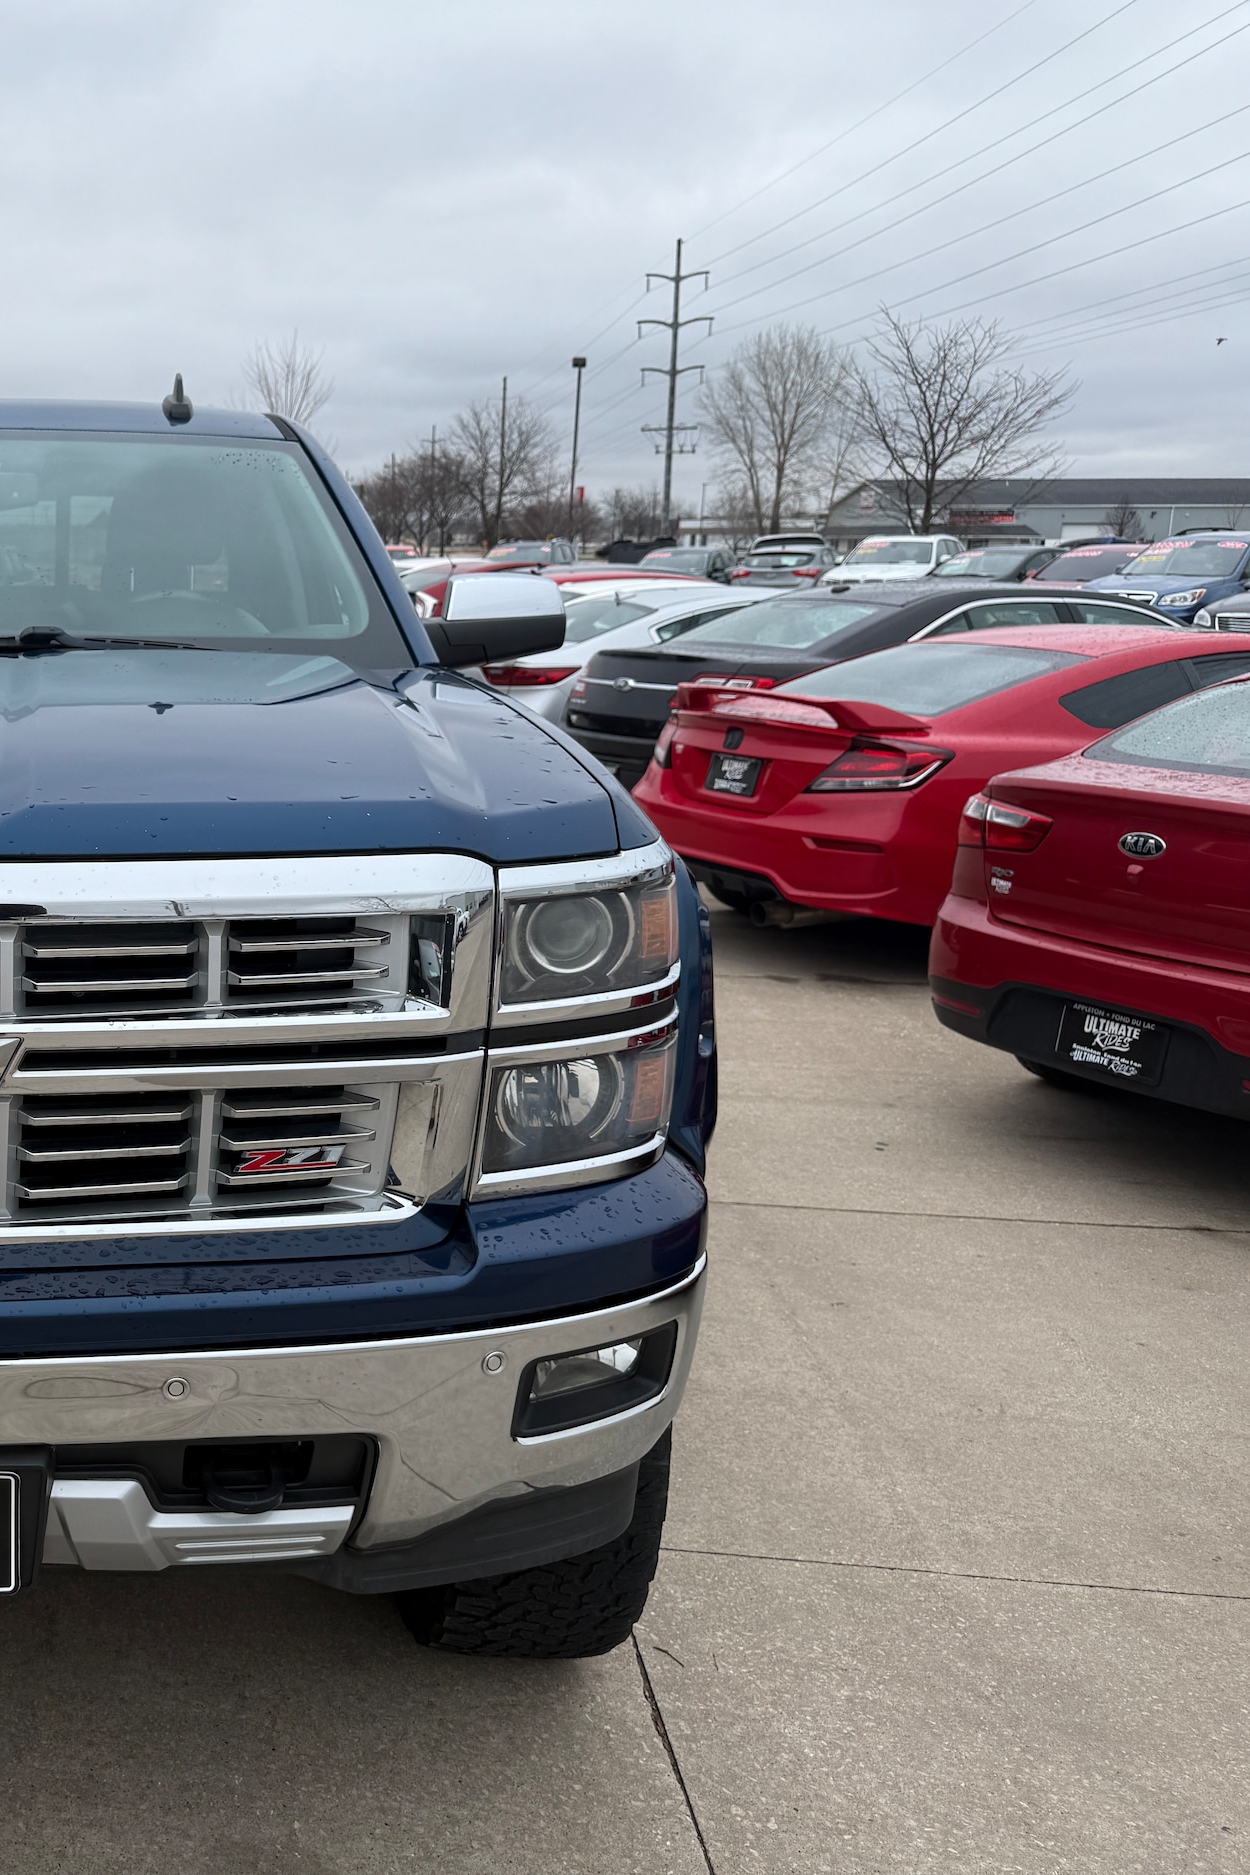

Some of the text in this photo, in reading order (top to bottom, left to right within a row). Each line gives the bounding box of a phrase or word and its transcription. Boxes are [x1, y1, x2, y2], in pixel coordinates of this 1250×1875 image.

[1125, 836, 1156, 853] KIA
[1073, 1003, 1156, 1030] APPLETON FOND DU LAC
[1083, 1014, 1141, 1040] ULTIMATE
[1072, 1049, 1109, 1066] ULTIMATE
[233, 1144, 346, 1172] Z71
